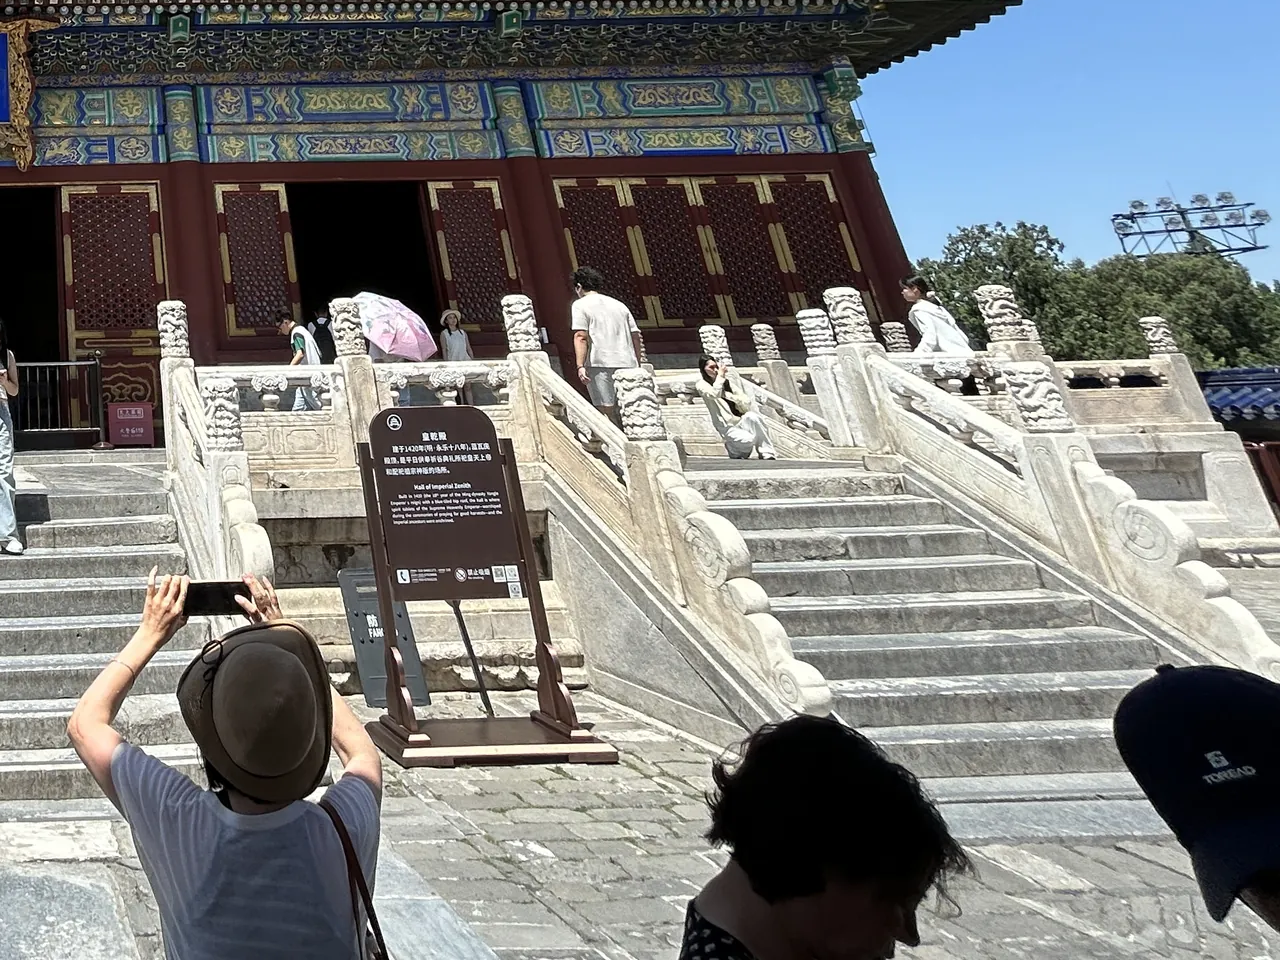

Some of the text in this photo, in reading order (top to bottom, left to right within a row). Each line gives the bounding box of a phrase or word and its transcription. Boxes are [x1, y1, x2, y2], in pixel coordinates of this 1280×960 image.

[422, 432, 447, 442] 皇乾殿
[1202, 766, 1256, 784] TOREAD
